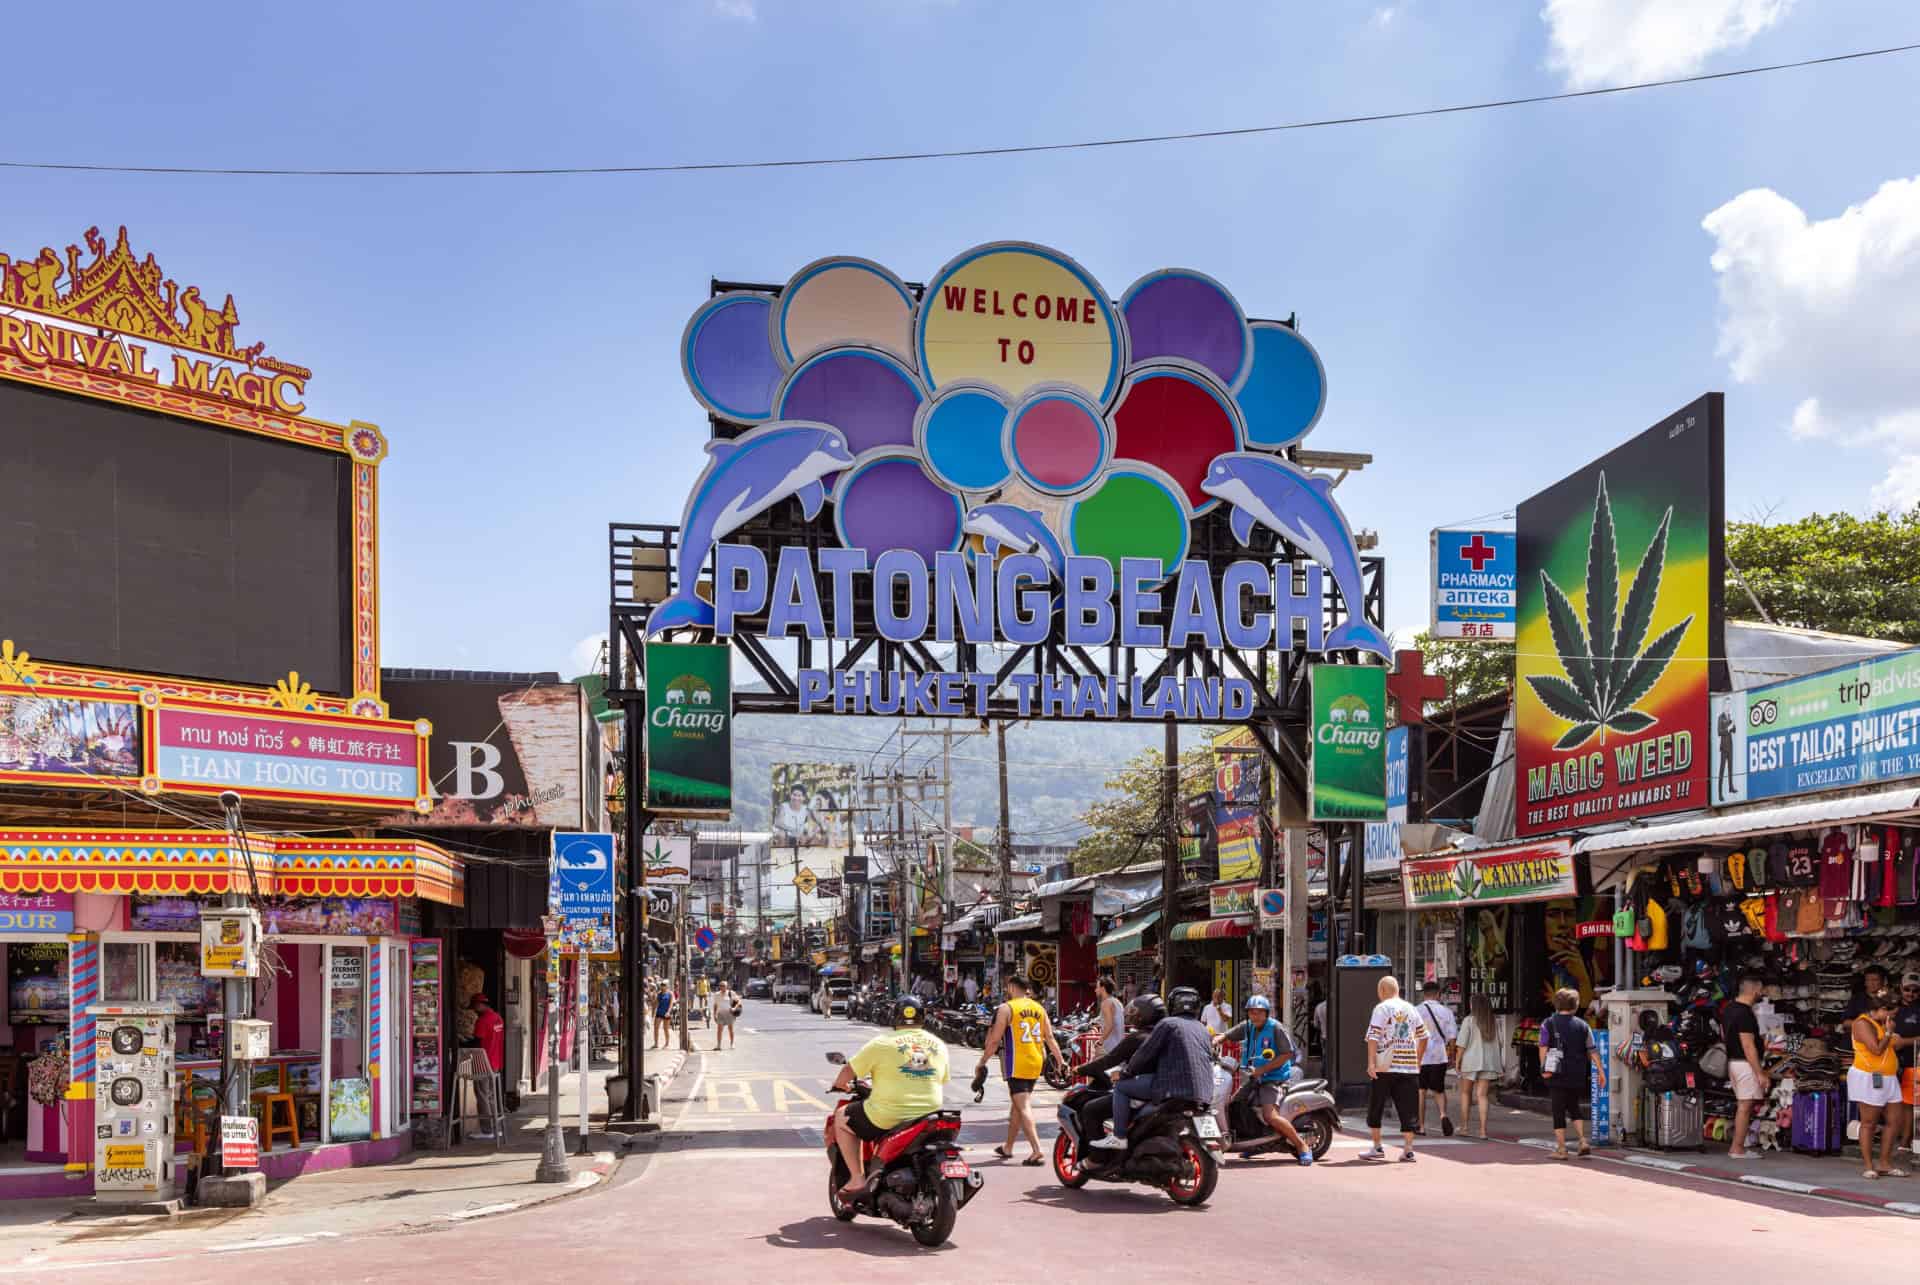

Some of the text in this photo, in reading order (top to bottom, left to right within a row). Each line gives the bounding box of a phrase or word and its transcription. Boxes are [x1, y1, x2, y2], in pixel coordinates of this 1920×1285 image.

[944, 285, 1097, 324] WELCOME
[997, 338, 1035, 365] TO
[174, 354, 306, 414] MAGIC
[1441, 573, 1515, 588] PHARMACY
[714, 543, 1325, 652] PATONG BEACH
[1446, 591, 1510, 604] аптека
[1461, 623, 1494, 637] 药店
[799, 668, 999, 717] PHUKET
[652, 706, 726, 733] Chang
[255, 728, 284, 750] ทัวร์
[1318, 723, 1382, 750] Chang
[1749, 708, 1920, 773] BEST TAILOR PHUKET
[180, 755, 403, 793] HAN HONG TOUR
[1528, 730, 1692, 802] MAGIC WEED
[1797, 764, 1857, 787] EXCELLENT
[1860, 762, 1877, 777] OF
[1880, 756, 1904, 775] THE
[1528, 810, 1543, 825] THE
[1547, 805, 1569, 821] BEST
[1573, 796, 1614, 817] QUALITY
[1617, 786, 1672, 809] CANNABIS
[1412, 858, 1560, 897] HAPPY CANNABIS
[1792, 855, 1812, 875] 23
[1020, 1021, 1042, 1043] 24
